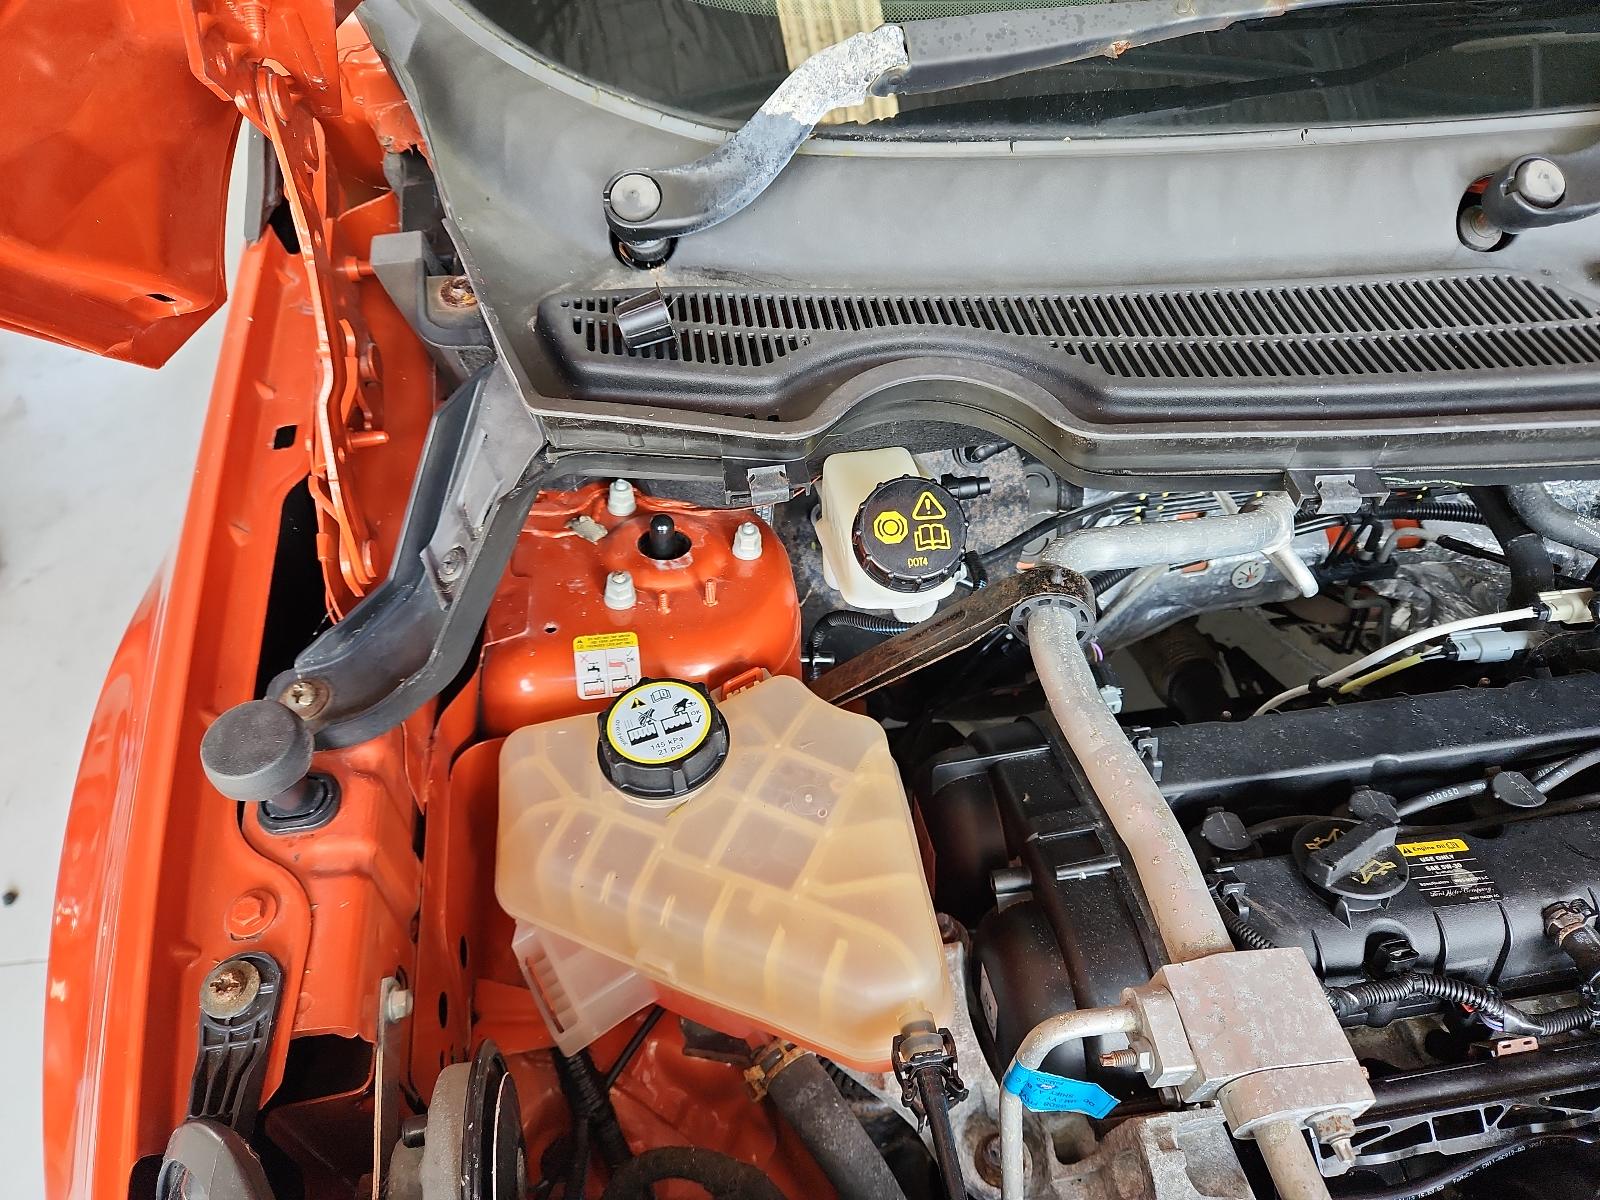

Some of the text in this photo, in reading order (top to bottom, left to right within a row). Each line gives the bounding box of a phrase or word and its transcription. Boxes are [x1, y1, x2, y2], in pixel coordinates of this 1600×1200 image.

[907, 556, 929, 568] DOT4
[651, 735, 684, 751] 145 kPa
[658, 744, 684, 756] 21 psi
[1429, 889, 1445, 897] Ford
